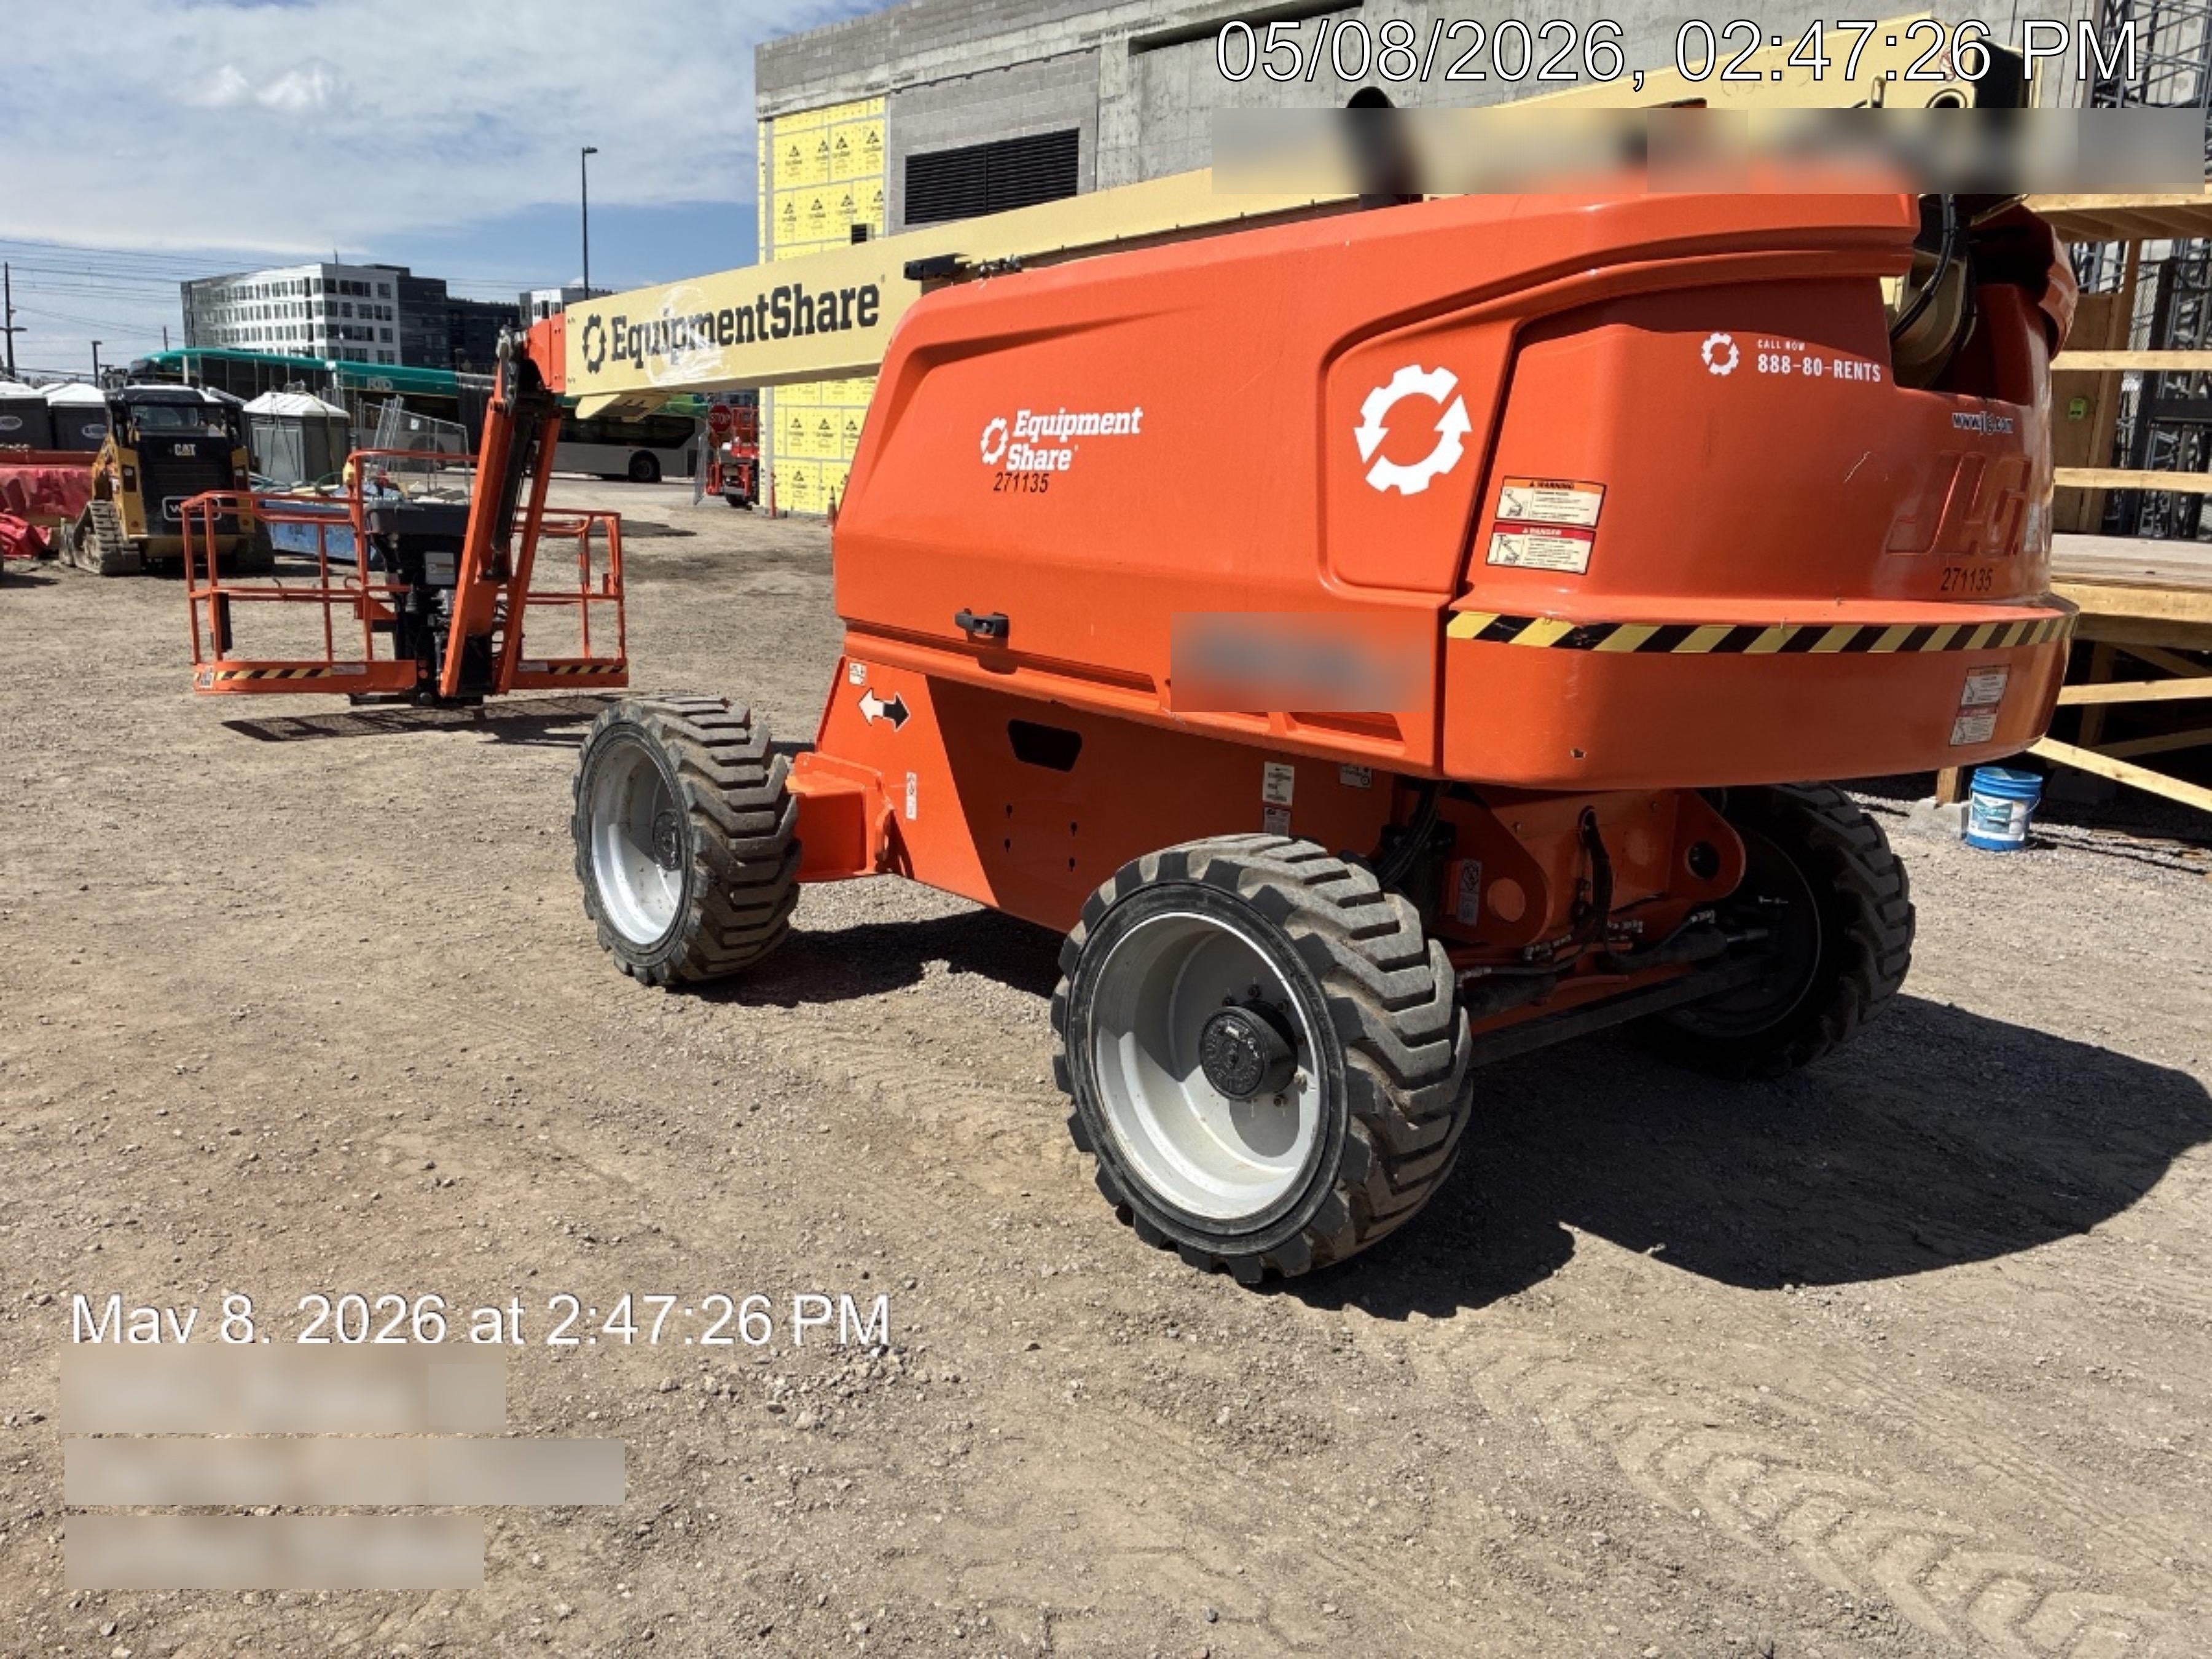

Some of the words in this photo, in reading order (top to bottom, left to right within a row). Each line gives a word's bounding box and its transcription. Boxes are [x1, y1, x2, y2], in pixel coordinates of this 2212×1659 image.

[611, 283, 879, 369] EquipmentShare
[1757, 339, 1781, 350] CALL
[1786, 340, 1805, 351] NOW
[1757, 354, 1881, 382] 888-80-RENTS
[709, 413, 731, 424] STOP
[1012, 407, 1143, 442] Equipment
[175, 443, 196, 456] CAT
[1006, 443, 1072, 471] Share
[993, 472, 1049, 493] 271135
[1940, 567, 1993, 591] 271135
